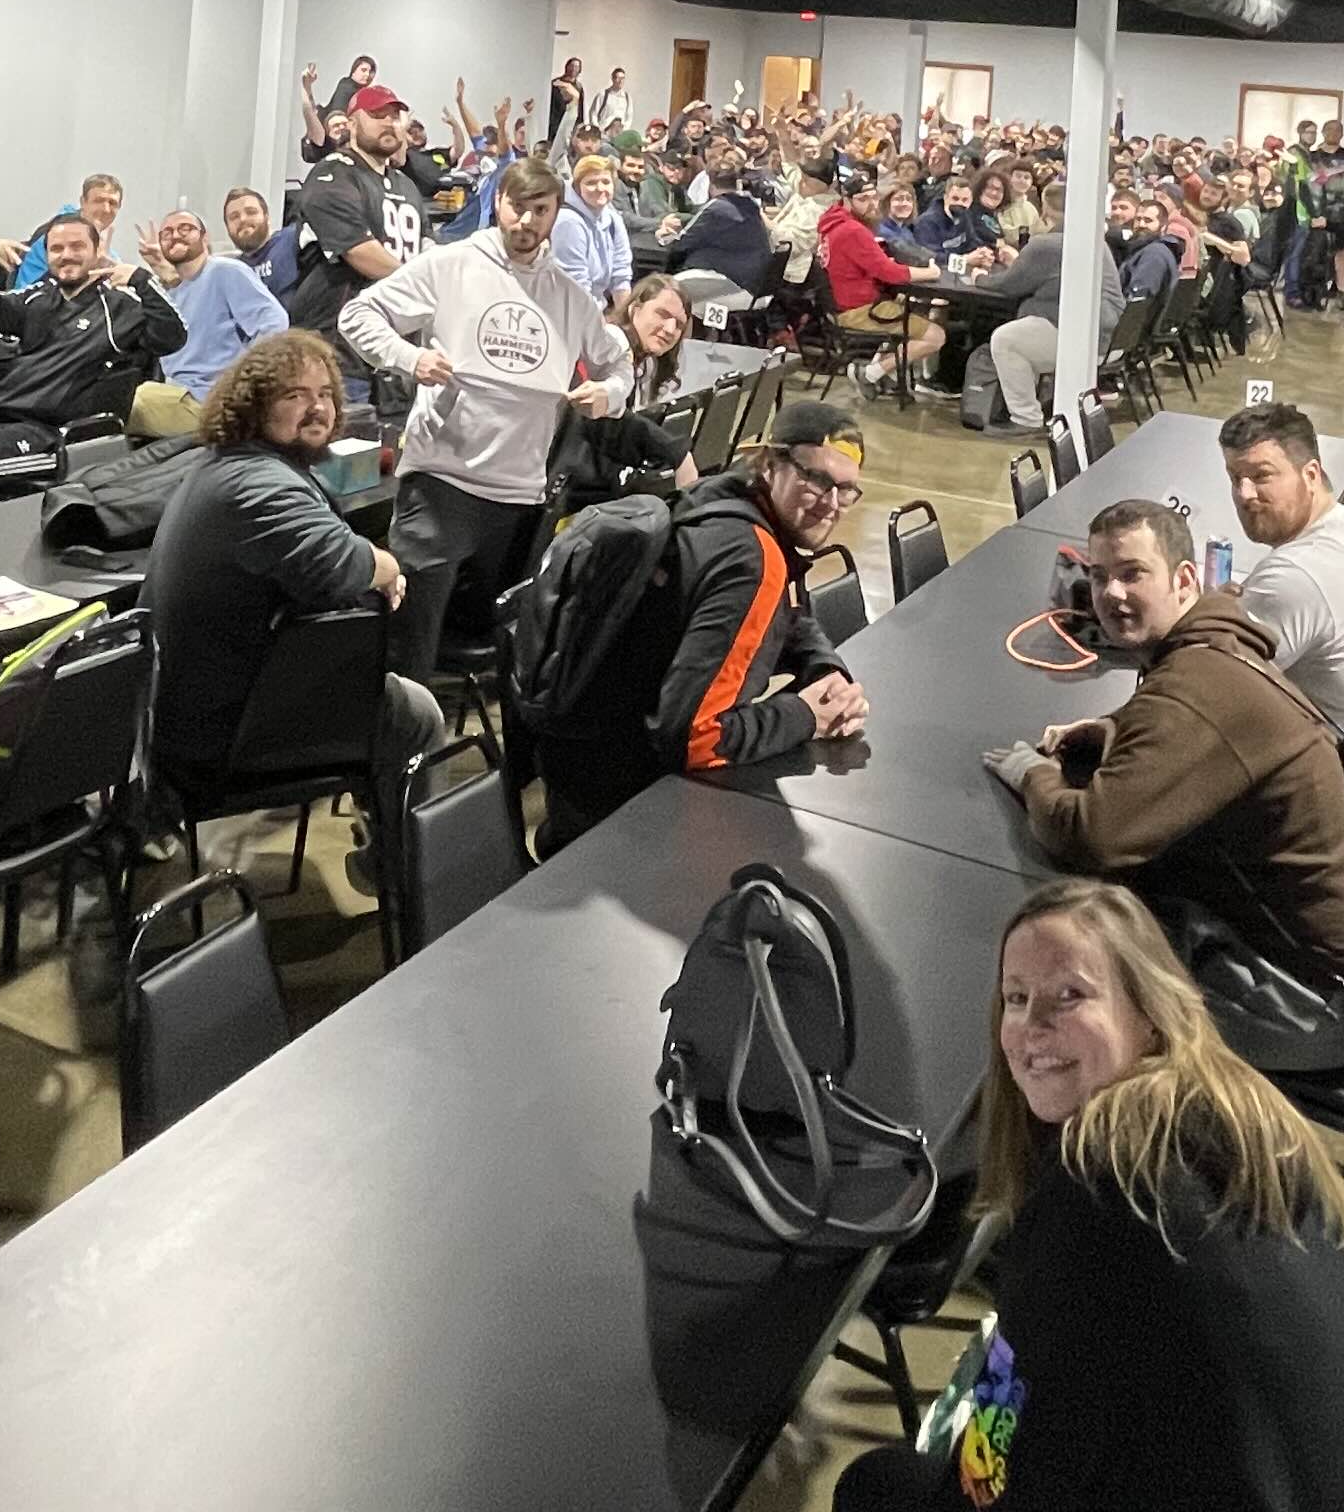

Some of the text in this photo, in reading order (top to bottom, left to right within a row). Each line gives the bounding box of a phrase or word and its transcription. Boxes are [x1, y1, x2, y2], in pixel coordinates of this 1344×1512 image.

[382, 198, 421, 264] 99
[708, 306, 724, 324] 26
[1251, 385, 1269, 402] 22
